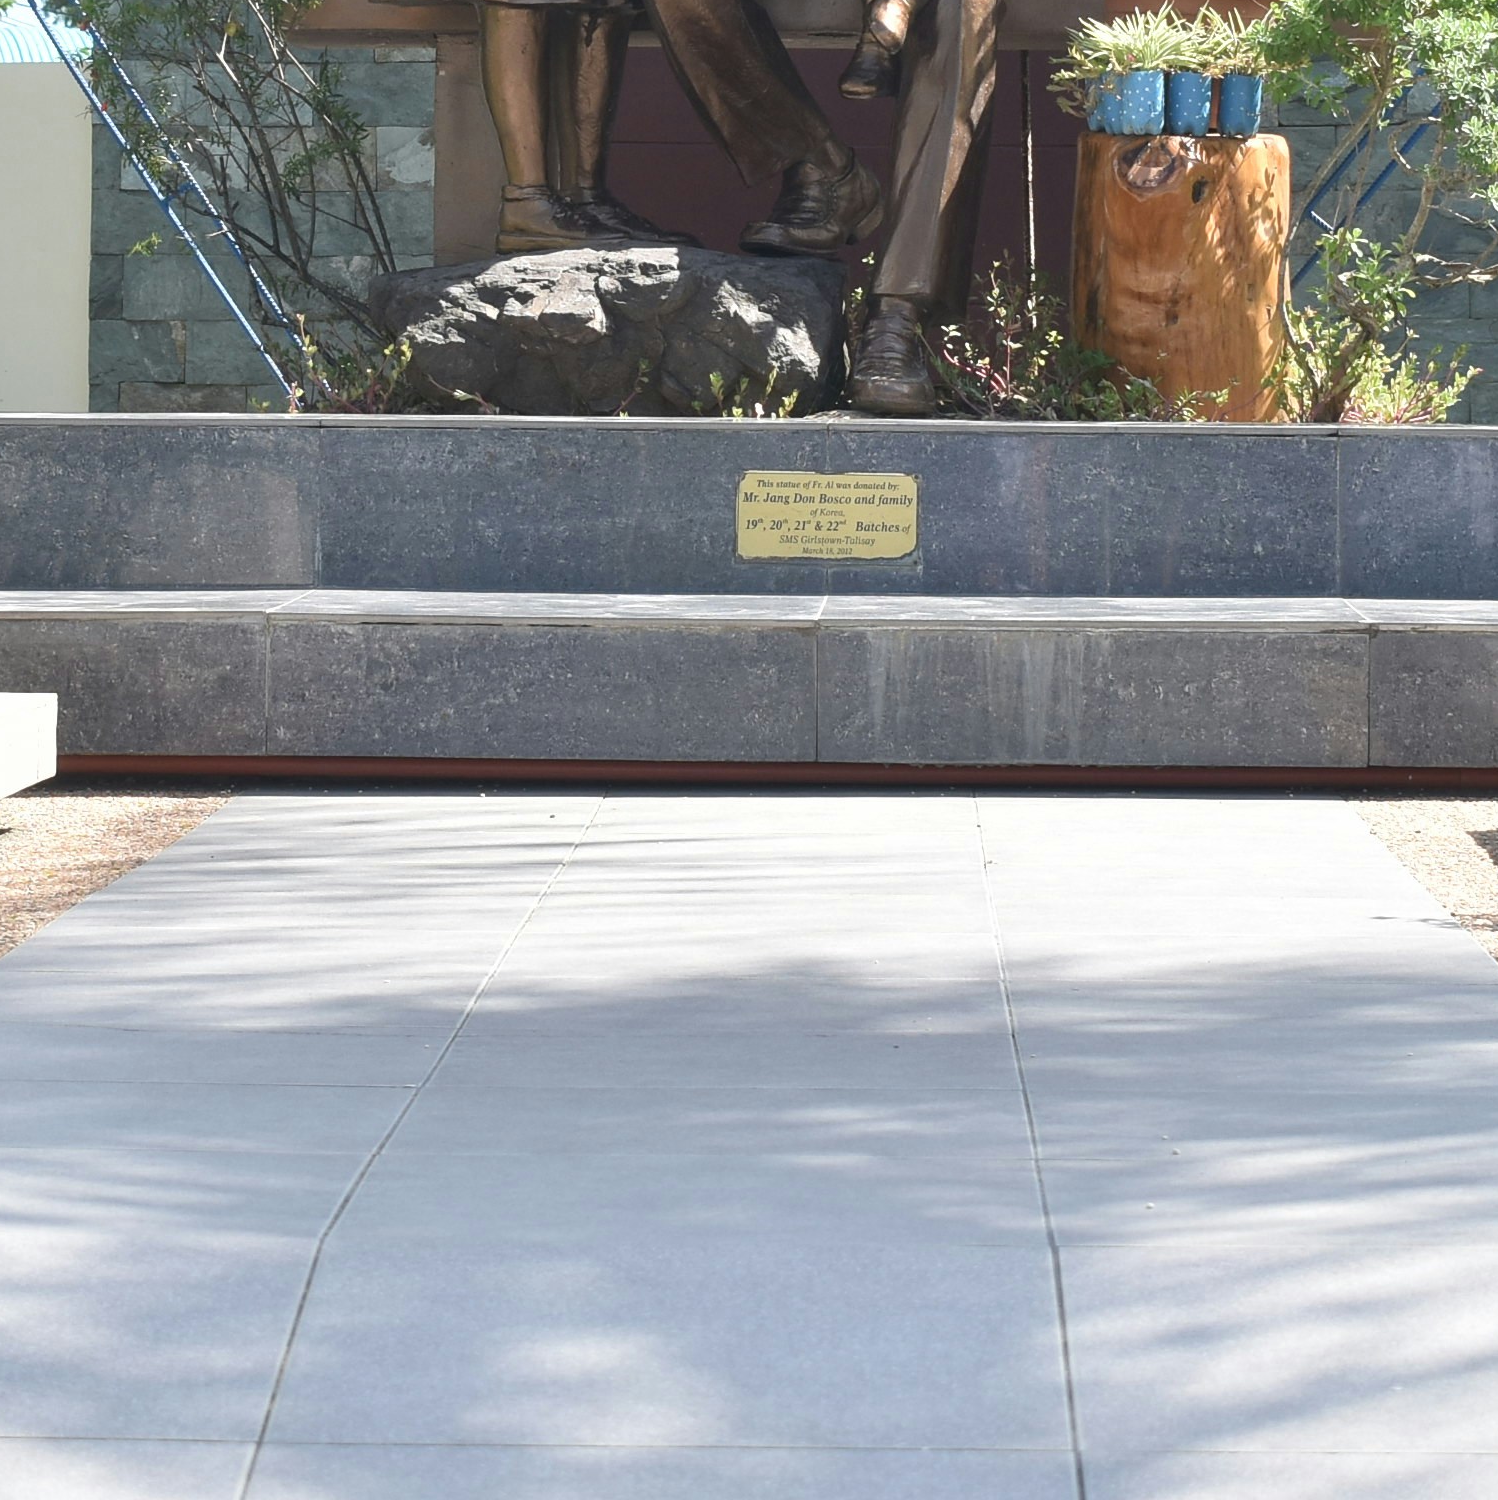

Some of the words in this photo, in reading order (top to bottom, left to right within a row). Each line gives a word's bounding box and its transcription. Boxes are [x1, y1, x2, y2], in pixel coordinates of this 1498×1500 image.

[757, 479, 774, 488] This
[776, 481, 801, 489] statue
[803, 480, 811, 490] of
[812, 481, 823, 489] Fr.
[825, 481, 834, 489] Al
[853, 481, 886, 490] donated
[742, 492, 760, 502] Mr.
[763, 492, 790, 505] Jang
[793, 493, 815, 503] Don
[819, 493, 852, 504] Bosco
[854, 494, 876, 505] and
[876, 494, 914, 507] family
[809, 508, 819, 518] of
[819, 508, 845, 517] Korea,
[814, 521, 823, 531] &
[855, 521, 900, 532] Batches
[901, 524, 912, 535] of
[779, 535, 799, 544] SMS
[802, 547, 824, 555] March
[836, 547, 853, 555] 2012
